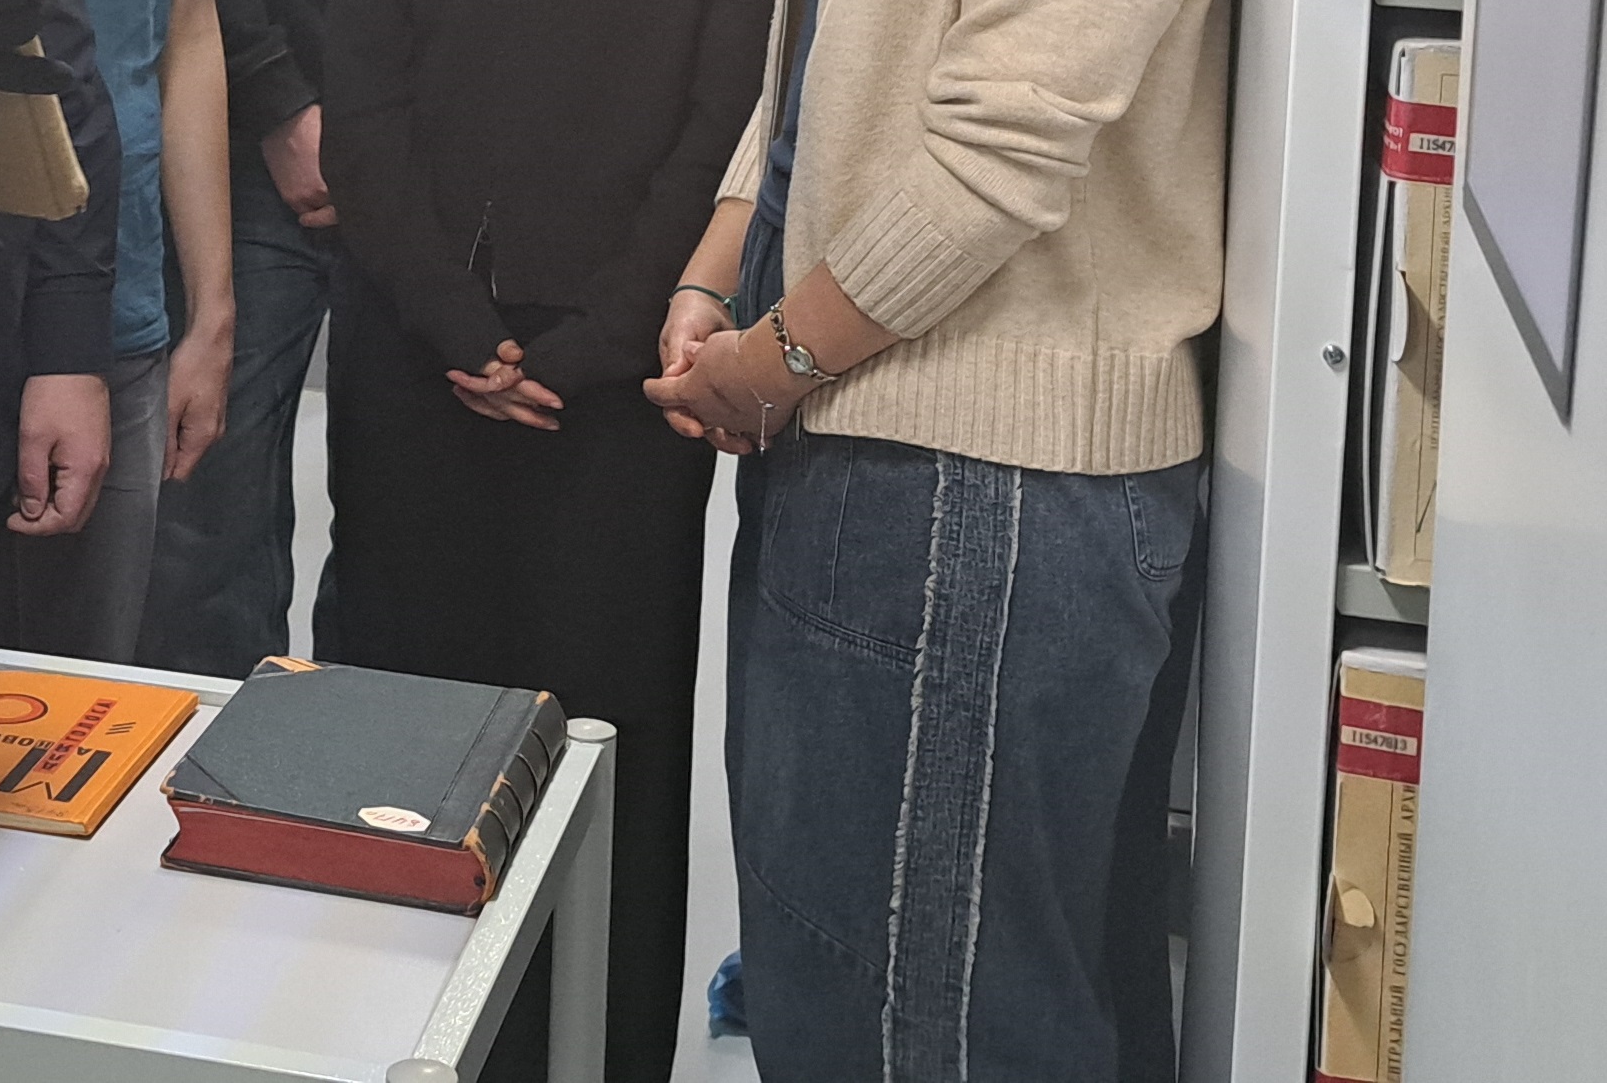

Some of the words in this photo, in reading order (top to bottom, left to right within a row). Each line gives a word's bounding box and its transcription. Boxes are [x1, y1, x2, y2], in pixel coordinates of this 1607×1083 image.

[1418, 137, 1456, 153] 11547
[1391, 832, 1414, 977] ГОСУДАРСТВЕННЫЙ
[1386, 983, 1406, 1082] ЕНТРАЛЬНЫЙ
